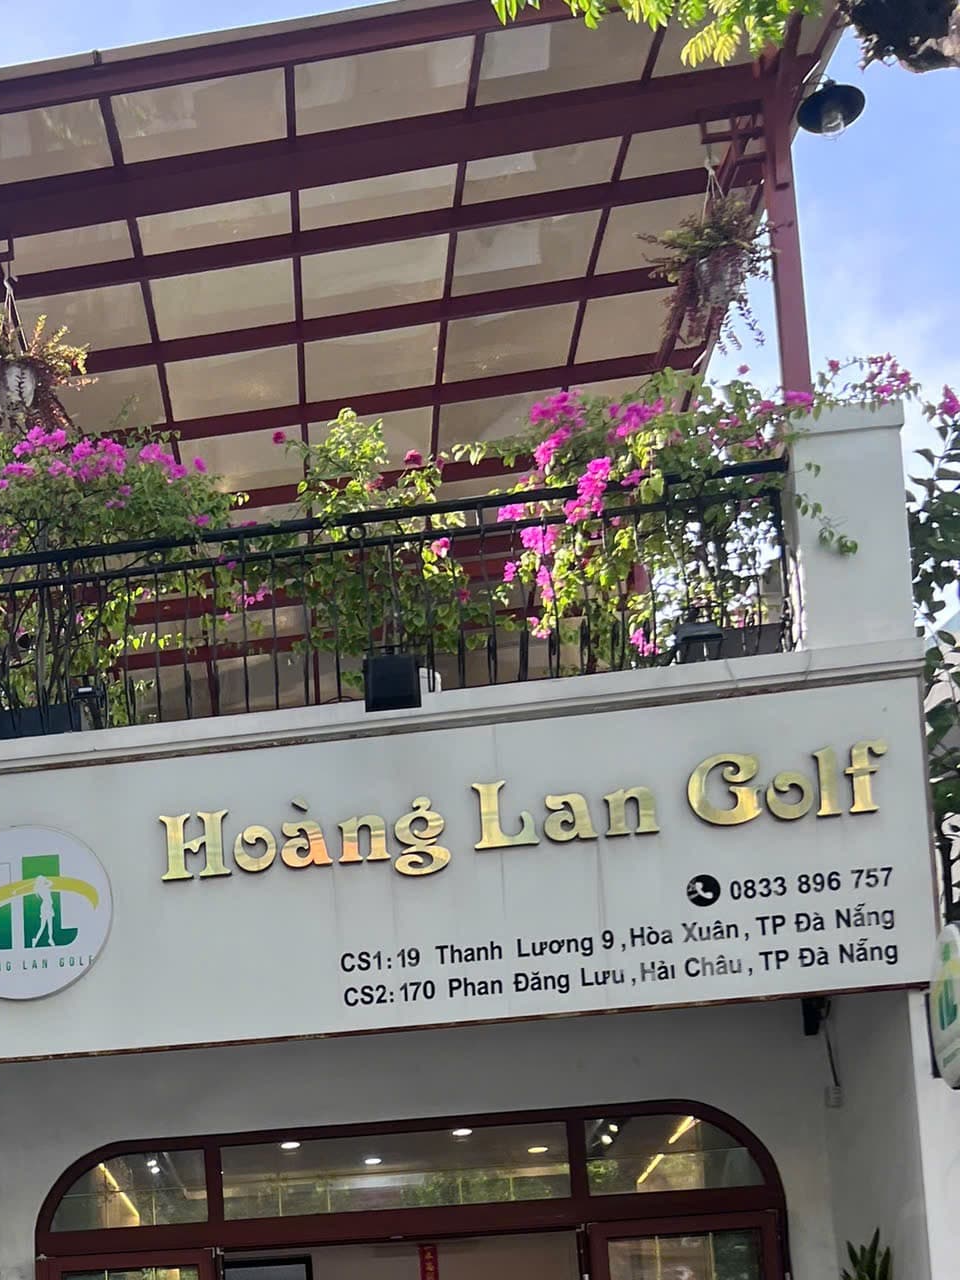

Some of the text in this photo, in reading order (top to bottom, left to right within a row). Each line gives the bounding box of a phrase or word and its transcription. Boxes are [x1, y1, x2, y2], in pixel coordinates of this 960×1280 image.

[159, 738, 888, 882] Hoàng Lan Golf
[730, 867, 893, 900] 0833 896 757
[23, 958, 48, 970] LAN
[435, 941, 503, 965] Thanh
[517, 935, 594, 957] Lương
[756, 915, 786, 936] TP
[795, 912, 825, 932] Đà
[835, 903, 895, 930] Nẵng
[448, 977, 503, 998] Phan
[513, 970, 570, 994] Đăng
[759, 950, 789, 971] TP
[799, 947, 829, 967] Đà
[839, 938, 899, 965] Nẵng
